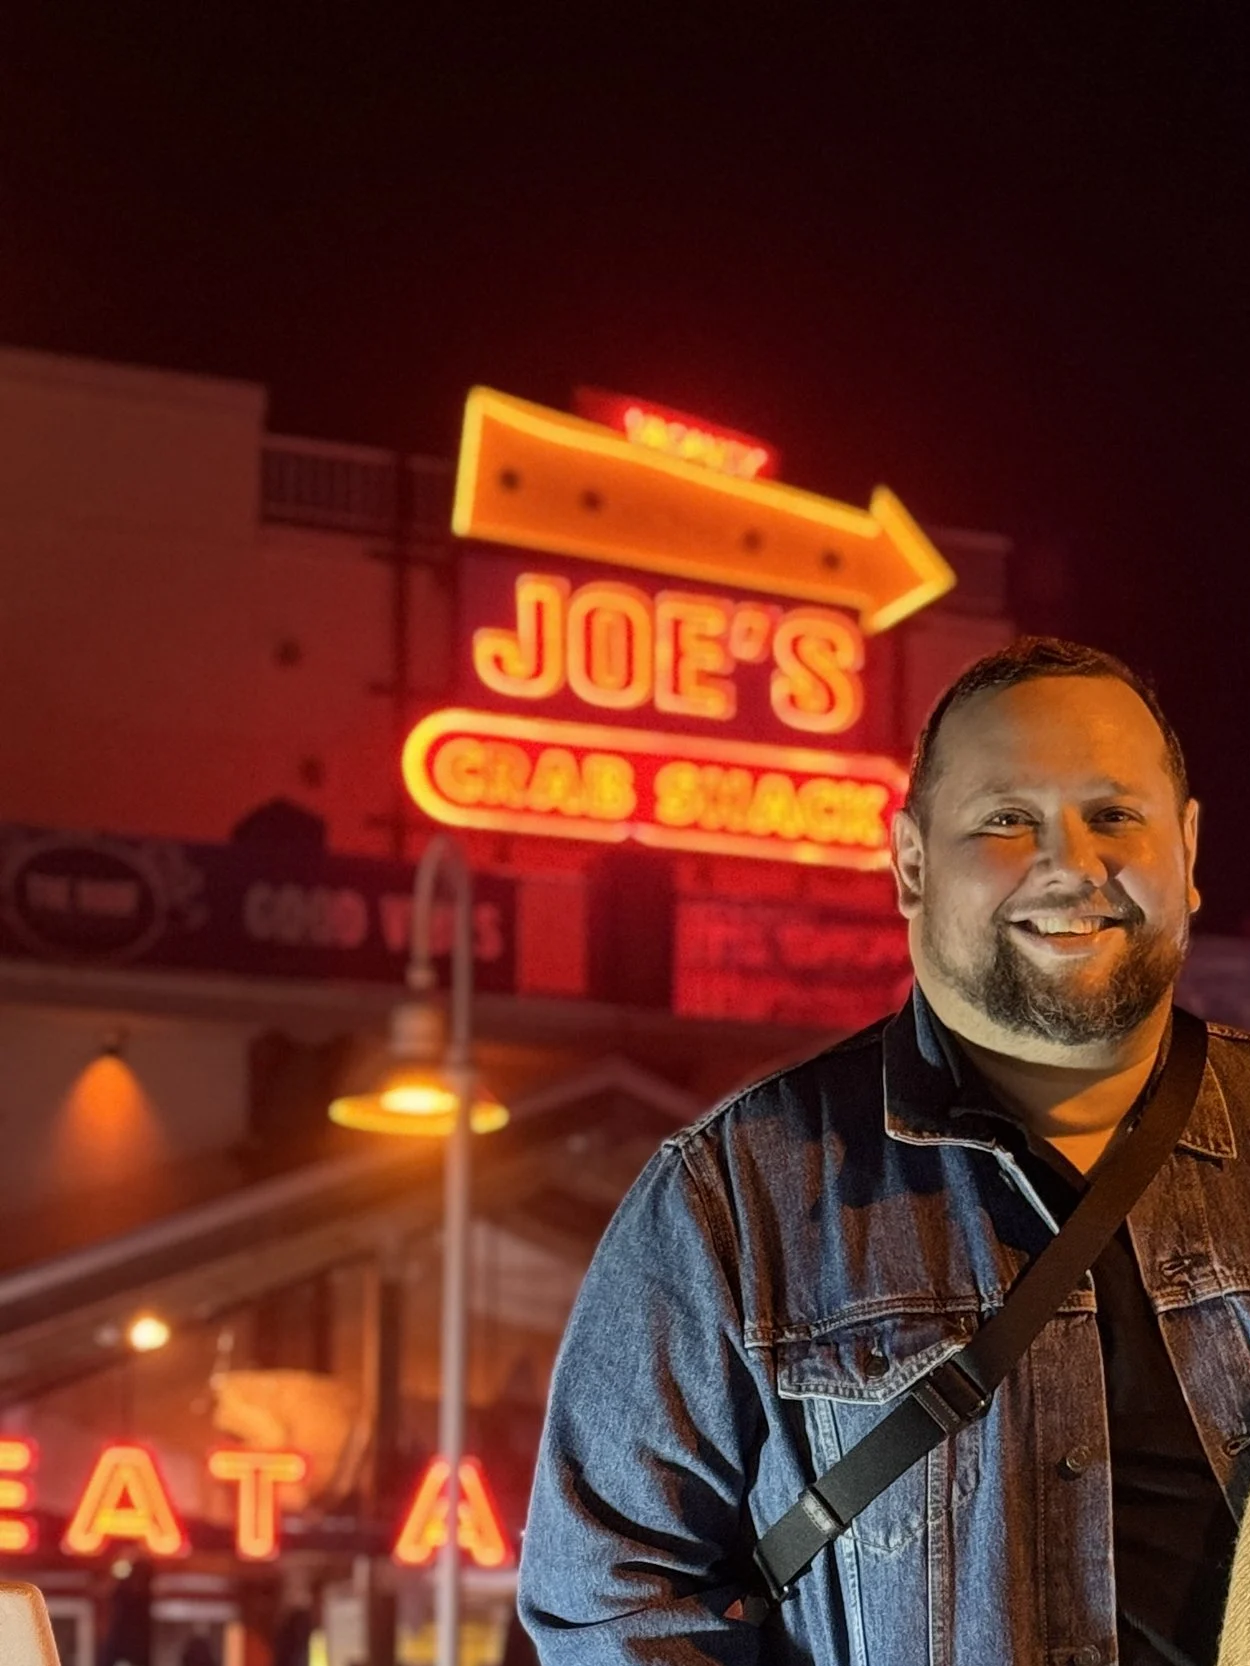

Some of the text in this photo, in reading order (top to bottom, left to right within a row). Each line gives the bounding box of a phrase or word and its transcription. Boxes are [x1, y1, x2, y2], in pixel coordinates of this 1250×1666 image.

[472, 571, 865, 734] JOE'S
[431, 738, 891, 847] CRAB SHACK
